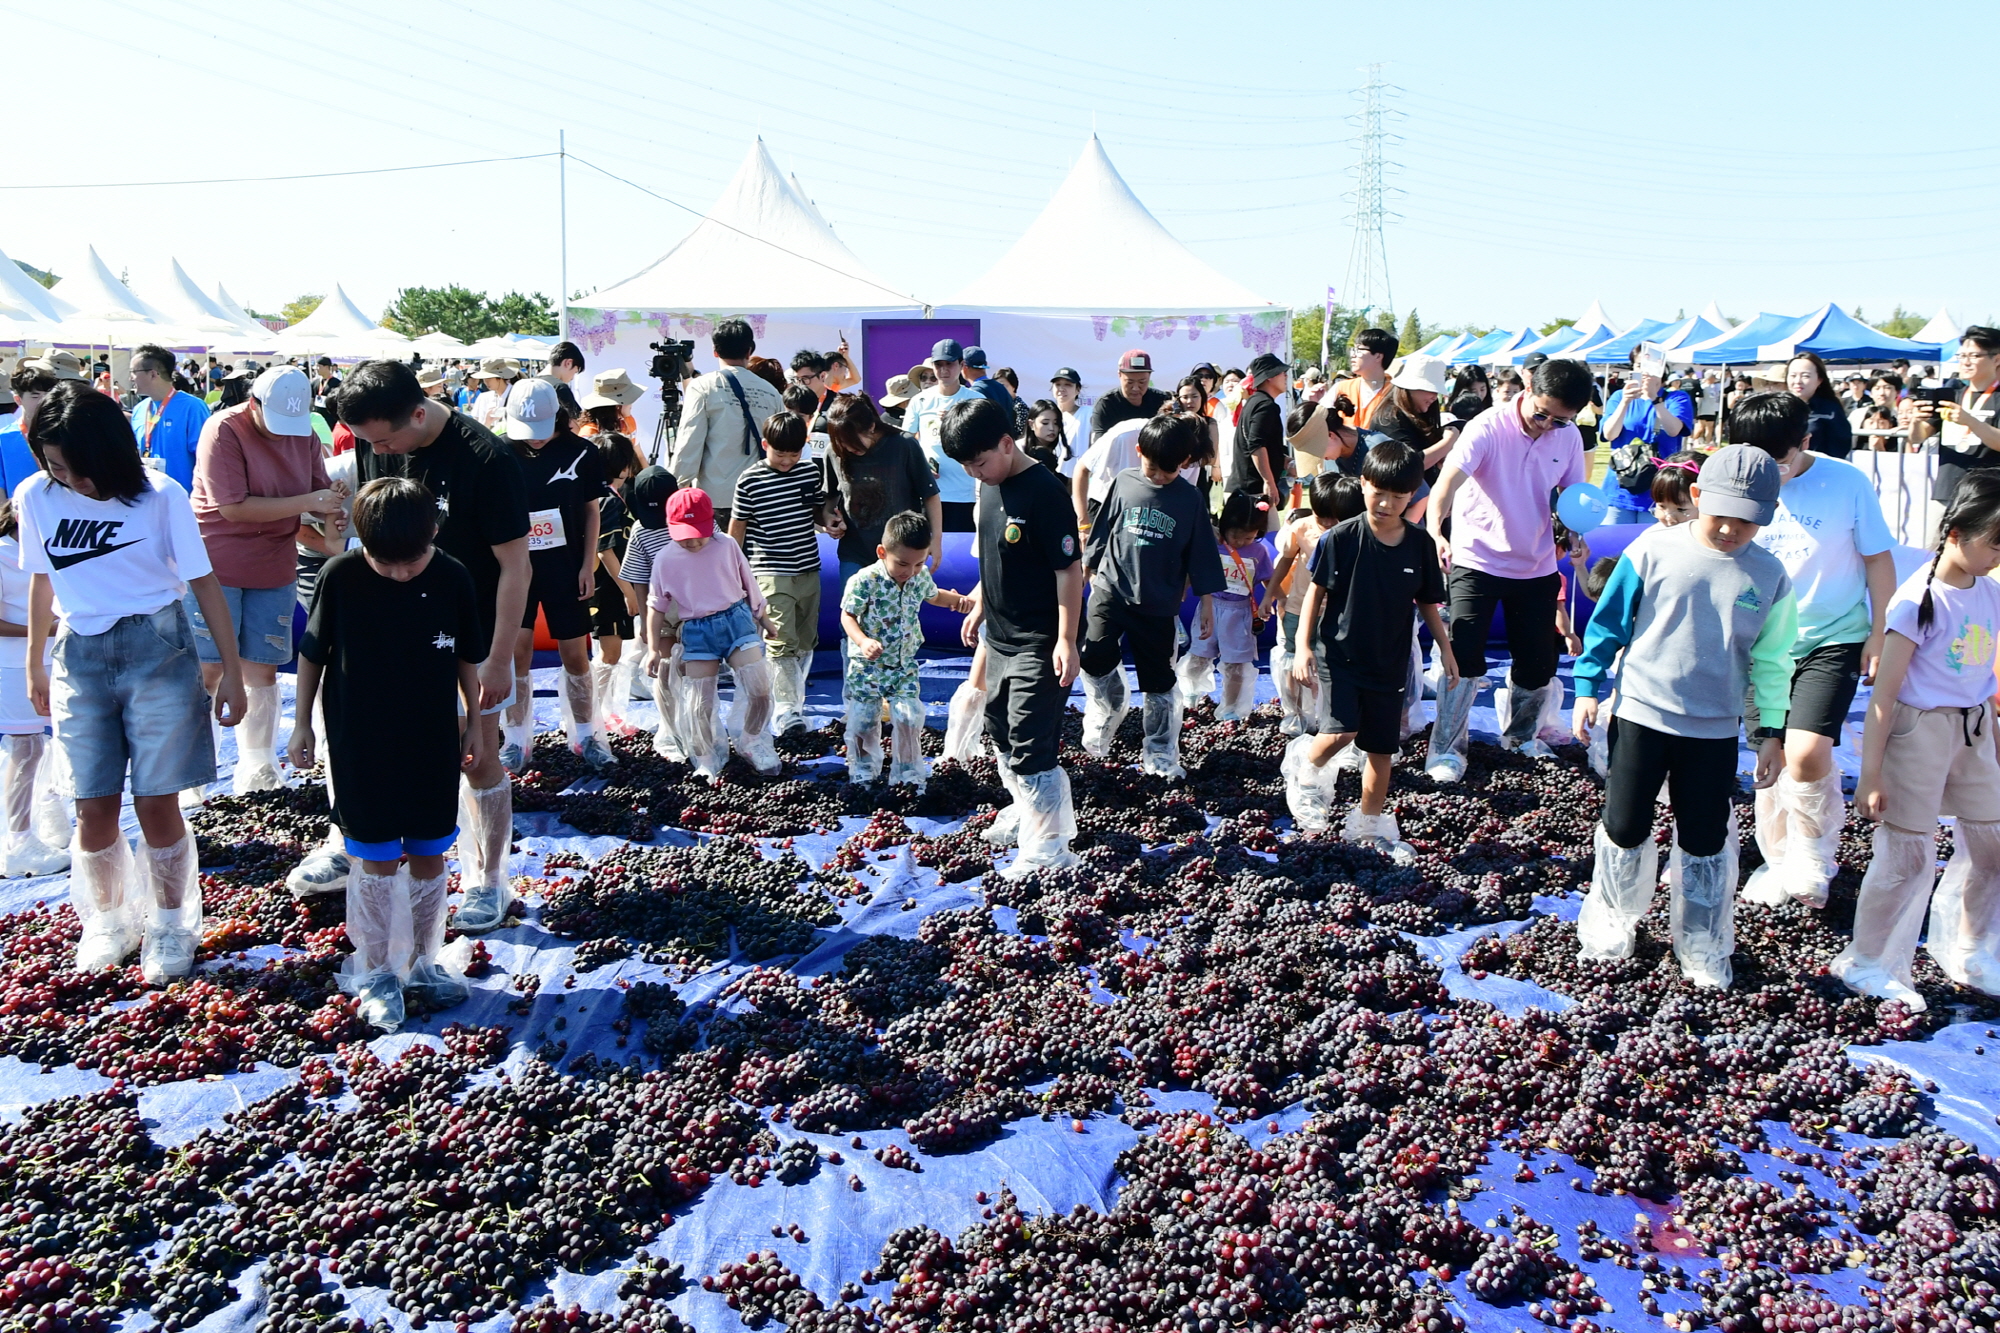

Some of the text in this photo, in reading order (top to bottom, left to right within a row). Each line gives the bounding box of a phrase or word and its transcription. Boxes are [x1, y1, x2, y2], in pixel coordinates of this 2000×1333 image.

[286, 397, 301, 413] NY
[520, 398, 537, 418] NY
[1123, 506, 1177, 539] LEAGUE
[51, 518, 125, 549] NIKE
[1143, 529, 1154, 538] FOR
